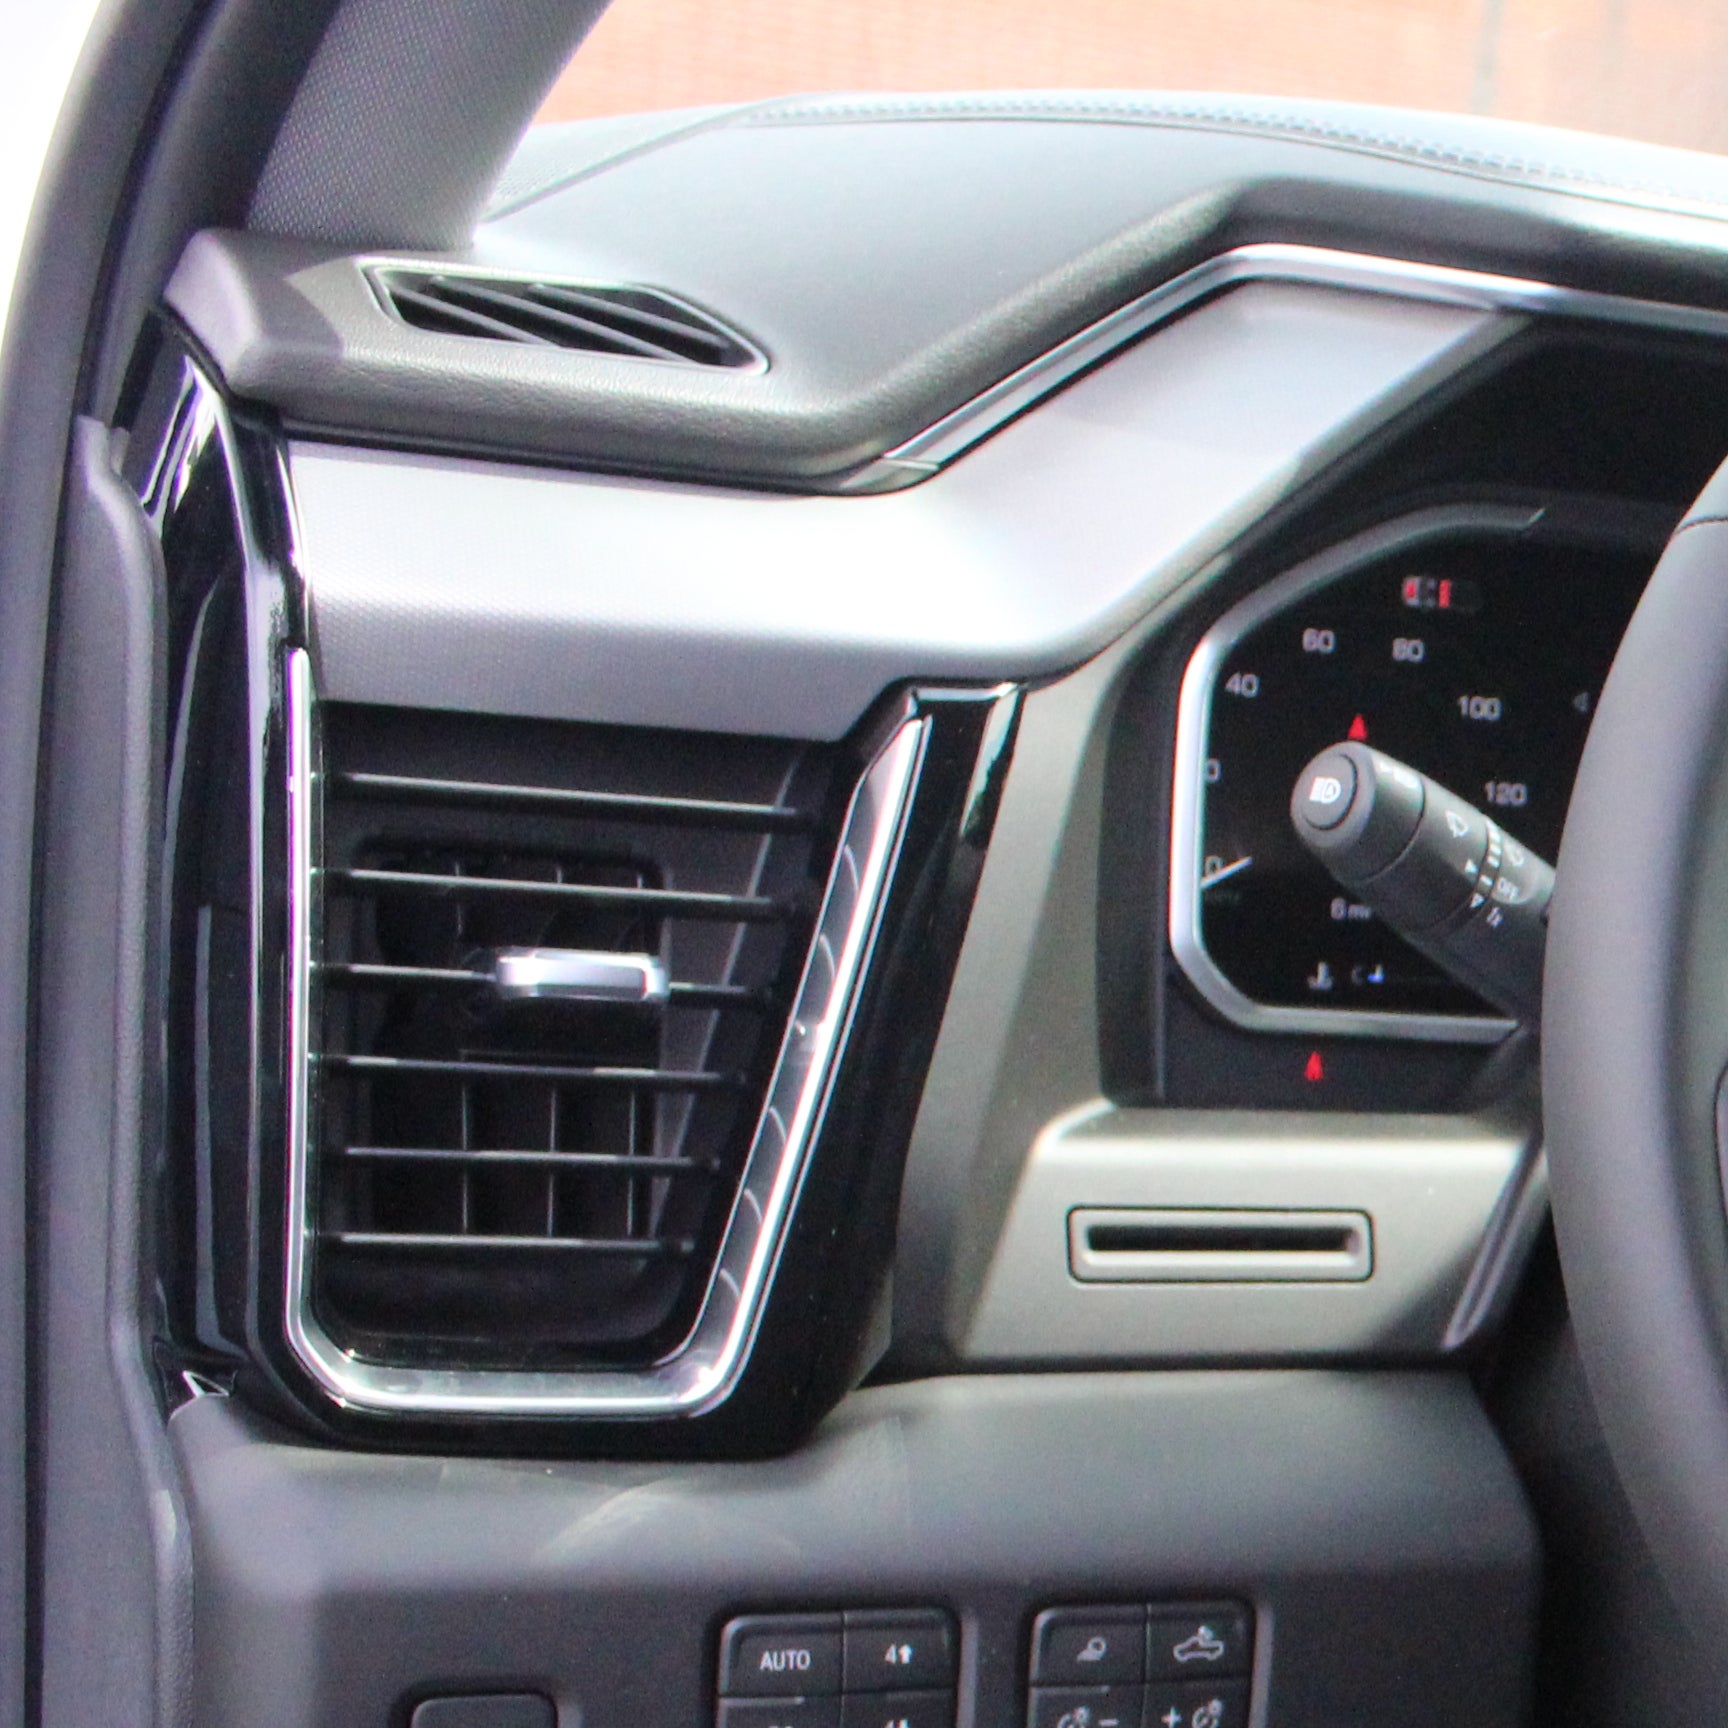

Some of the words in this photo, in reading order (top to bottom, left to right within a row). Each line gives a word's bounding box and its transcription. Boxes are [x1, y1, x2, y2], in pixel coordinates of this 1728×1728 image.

[1303, 628, 1335, 654] 60
[1392, 638, 1425, 663] 80
[1225, 672, 1259, 698] 40
[1457, 696, 1502, 721] 100
[1484, 780, 1529, 806] 120
[760, 1649, 811, 1672] AUTO
